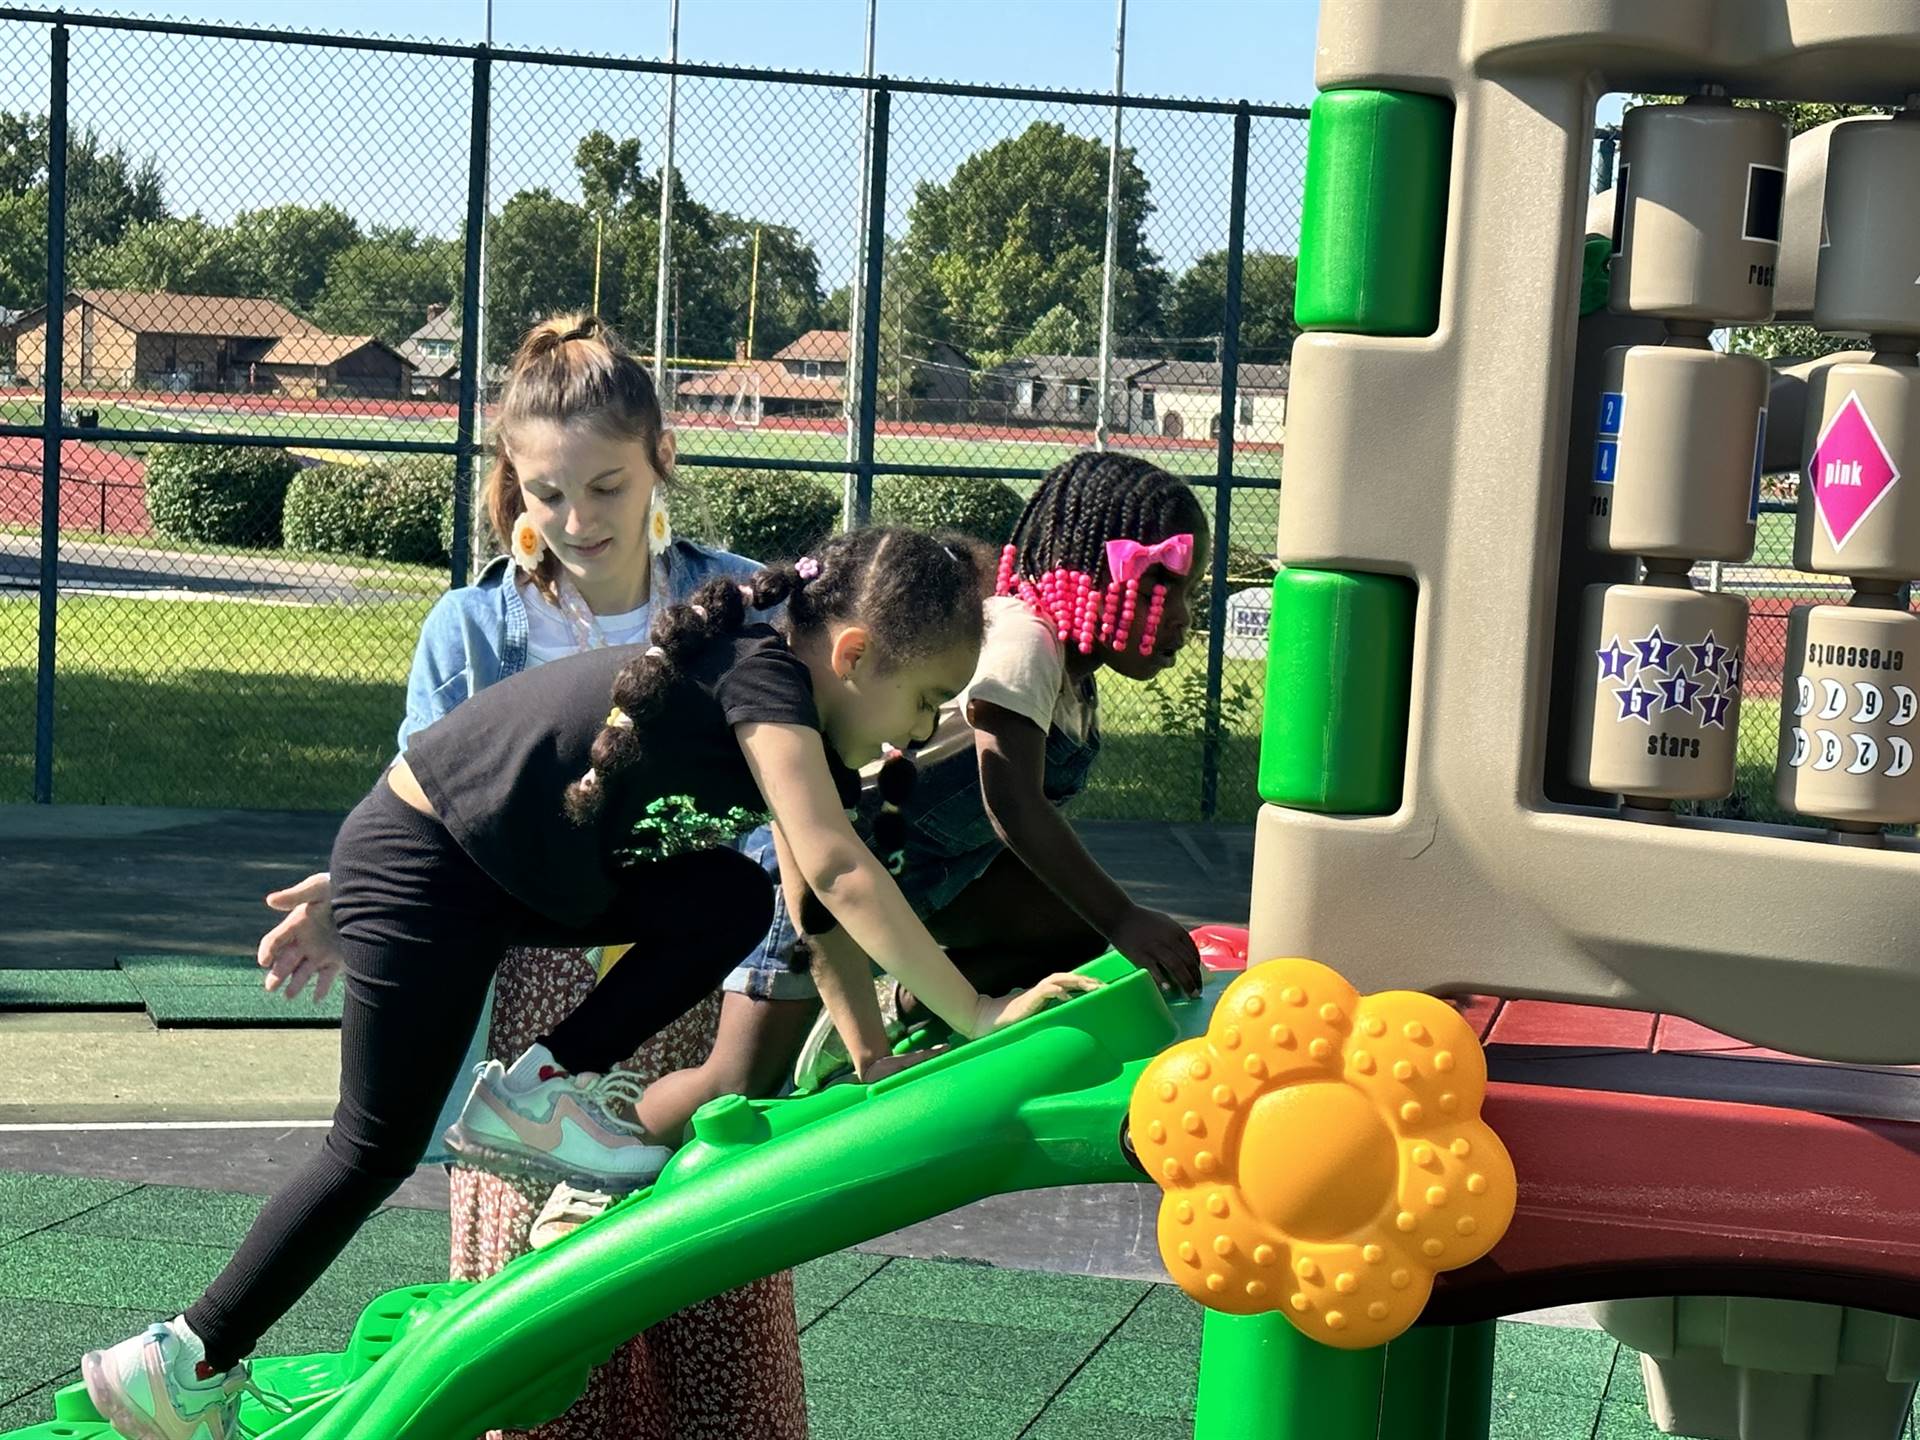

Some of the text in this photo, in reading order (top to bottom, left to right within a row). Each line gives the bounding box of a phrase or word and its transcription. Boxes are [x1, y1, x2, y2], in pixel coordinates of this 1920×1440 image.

[1605, 401, 1614, 425] 2
[1600, 449, 1609, 474] 4
[1824, 458, 1863, 489] pink
[1611, 638, 1738, 682] 1 2 3 4
[1808, 642, 1905, 672] crescents
[1630, 678, 1720, 718] 5 6 7
[1801, 684, 1912, 718] 5 6 7 8
[1647, 732, 1701, 759] stars
[1825, 739, 1835, 762] 3
[1859, 742, 1872, 766] 2
[1897, 744, 1905, 769] 1
